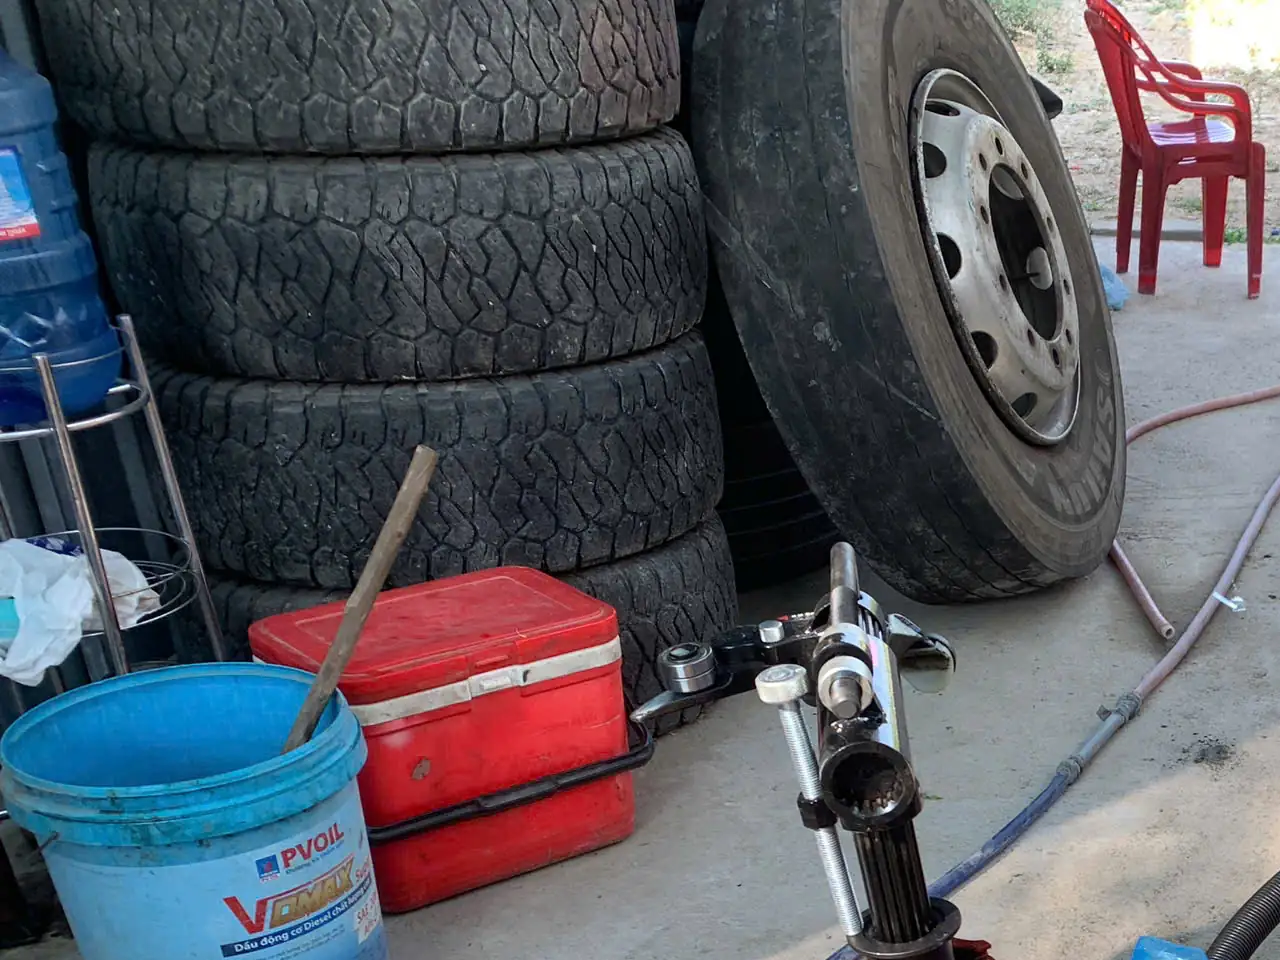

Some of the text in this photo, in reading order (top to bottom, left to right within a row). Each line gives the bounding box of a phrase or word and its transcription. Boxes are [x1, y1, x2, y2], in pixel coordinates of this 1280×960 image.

[280, 822, 345, 869] PVOIL
[222, 851, 355, 935] VOMAX
[304, 912, 331, 930] Diesel
